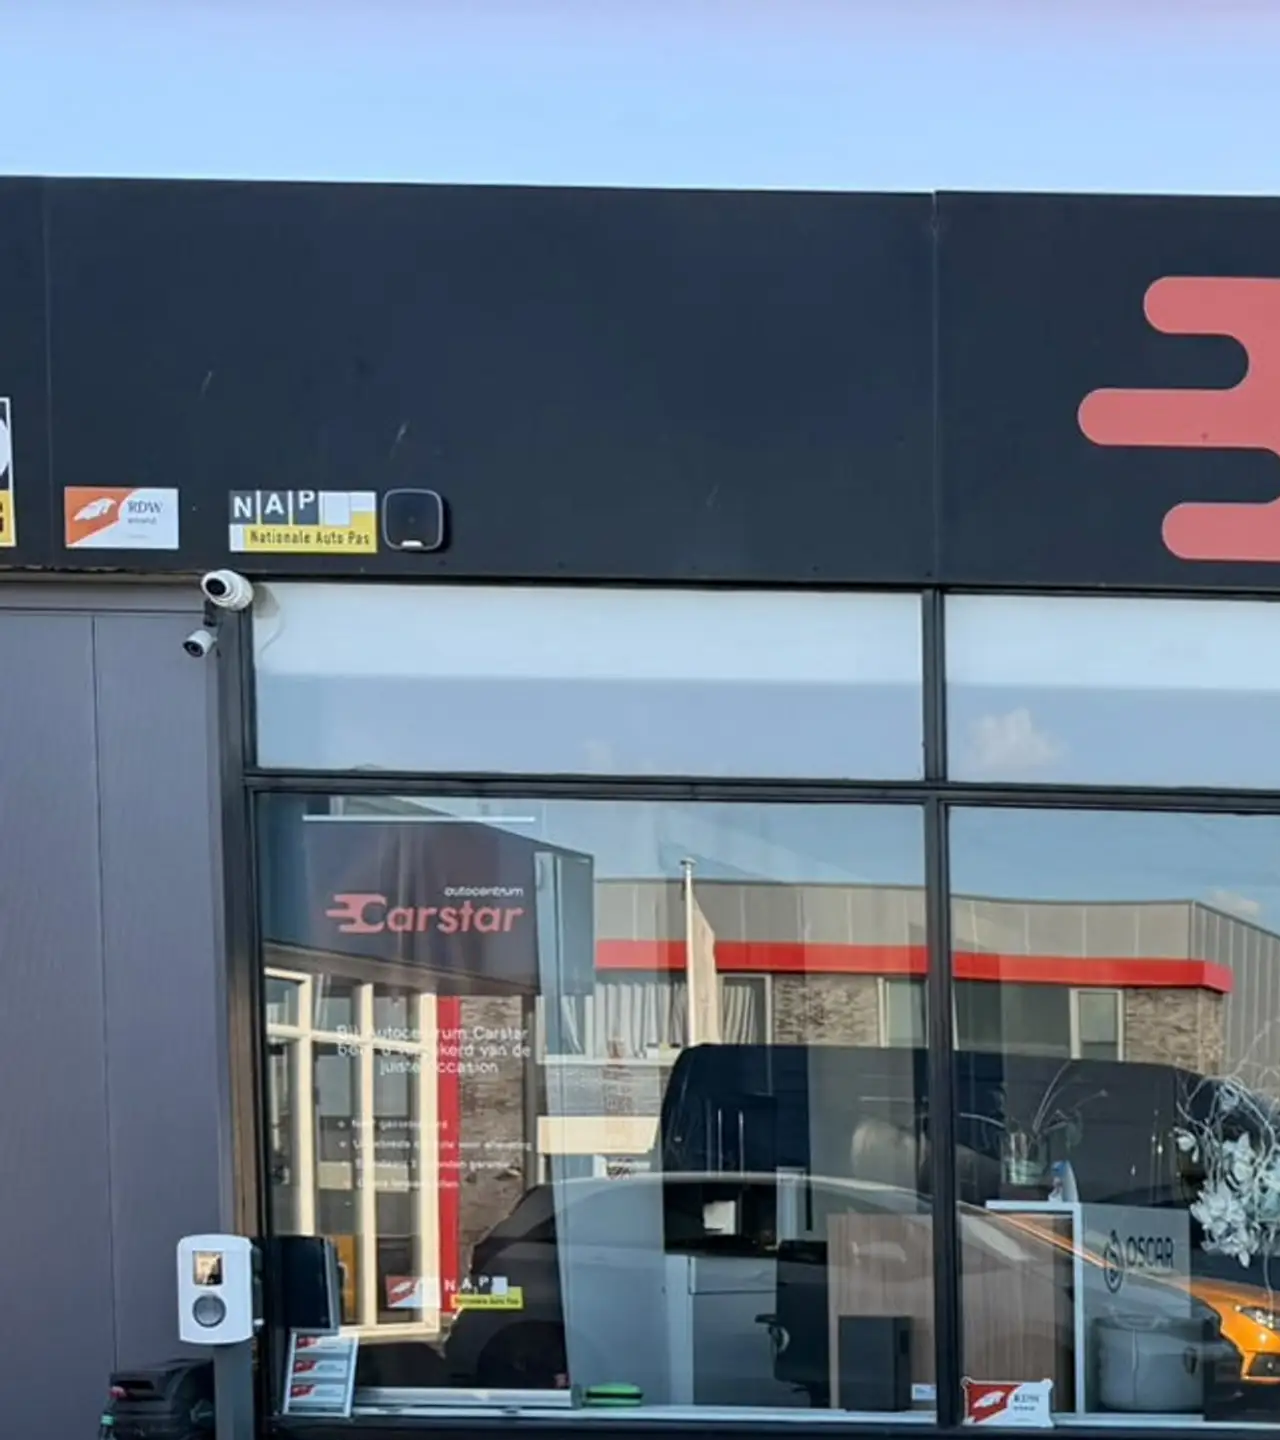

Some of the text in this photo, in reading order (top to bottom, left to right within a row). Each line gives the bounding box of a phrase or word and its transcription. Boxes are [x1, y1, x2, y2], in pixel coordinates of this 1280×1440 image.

[249, 530, 370, 545] Nationale Auto Pas
[444, 885, 524, 897] autocentrum
[325, 893, 525, 934] Carstar
